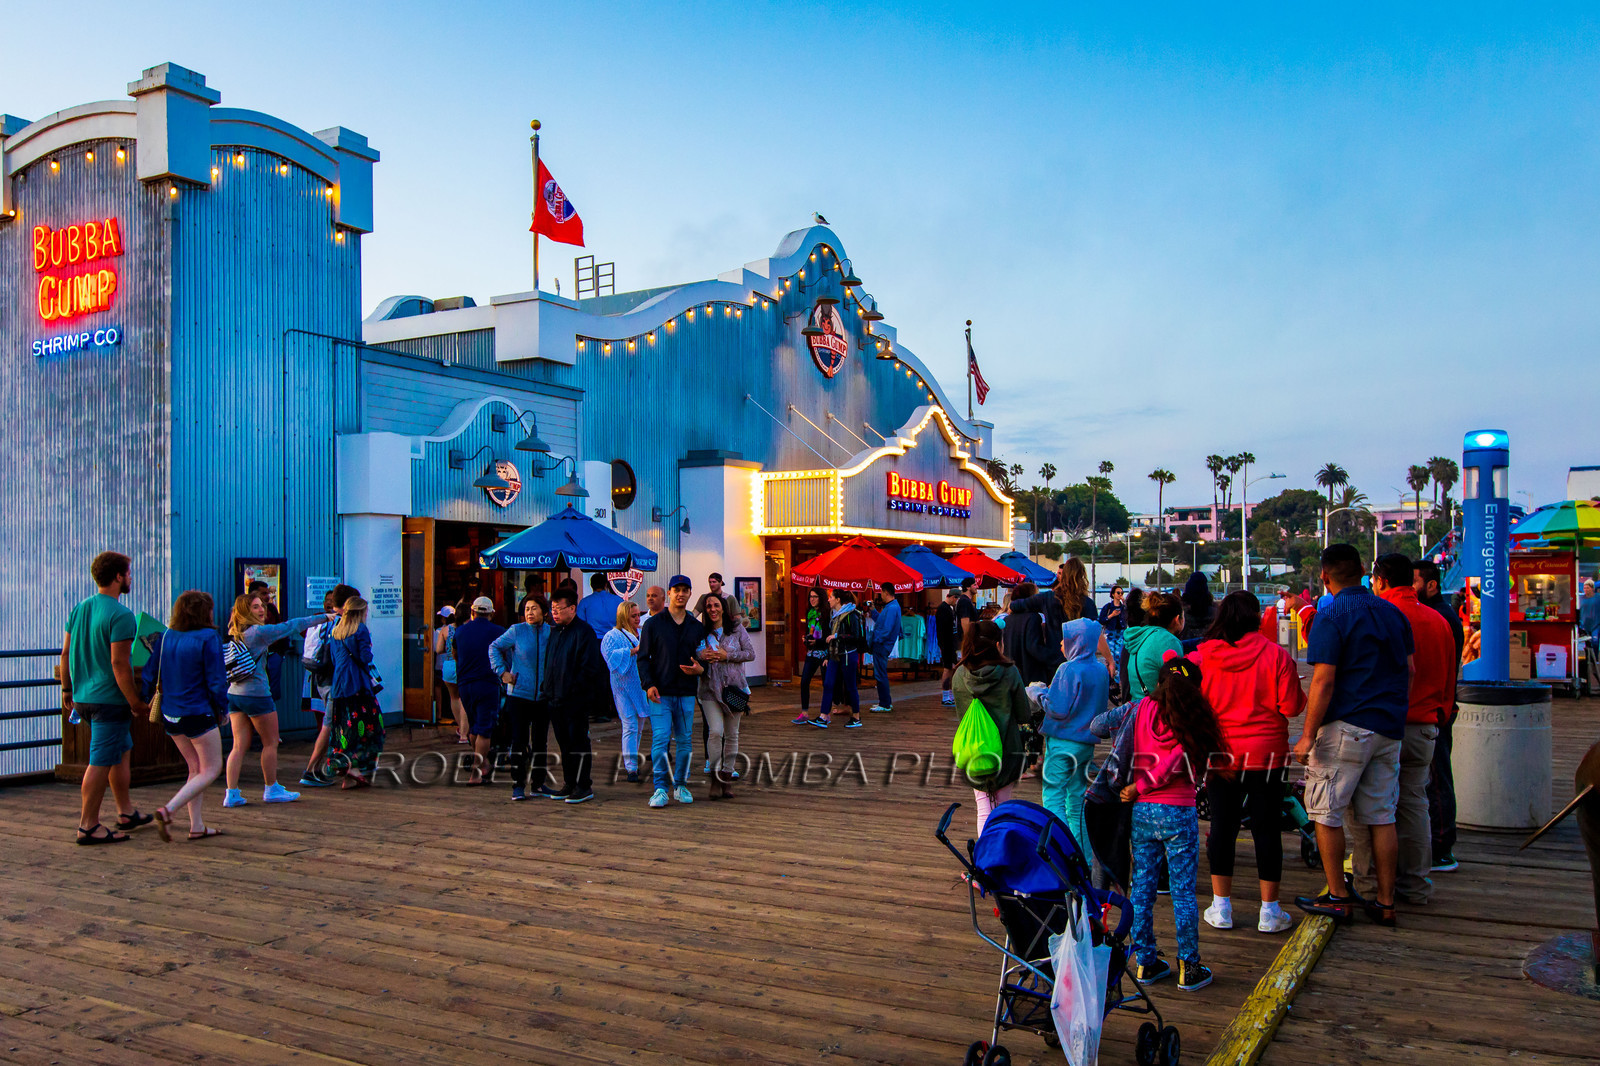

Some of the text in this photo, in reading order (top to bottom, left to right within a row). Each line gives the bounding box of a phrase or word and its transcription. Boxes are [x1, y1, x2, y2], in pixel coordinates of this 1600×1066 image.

[33, 217, 123, 272] BUBBA
[32, 328, 118, 356] SHRIMP CO
[888, 471, 972, 506] BUBBA GUMP
[594, 507, 607, 518] 301
[890, 499, 971, 518] SHRIMP COMPANY
[1481, 503, 1498, 598] Emergency
[503, 555, 537, 564] SHRIMP
[568, 555, 626, 566] BUBBA GUMP
[823, 579, 850, 588] SHRIMP
[894, 583, 913, 591] GUMP
[1457, 707, 1504, 723] onica
